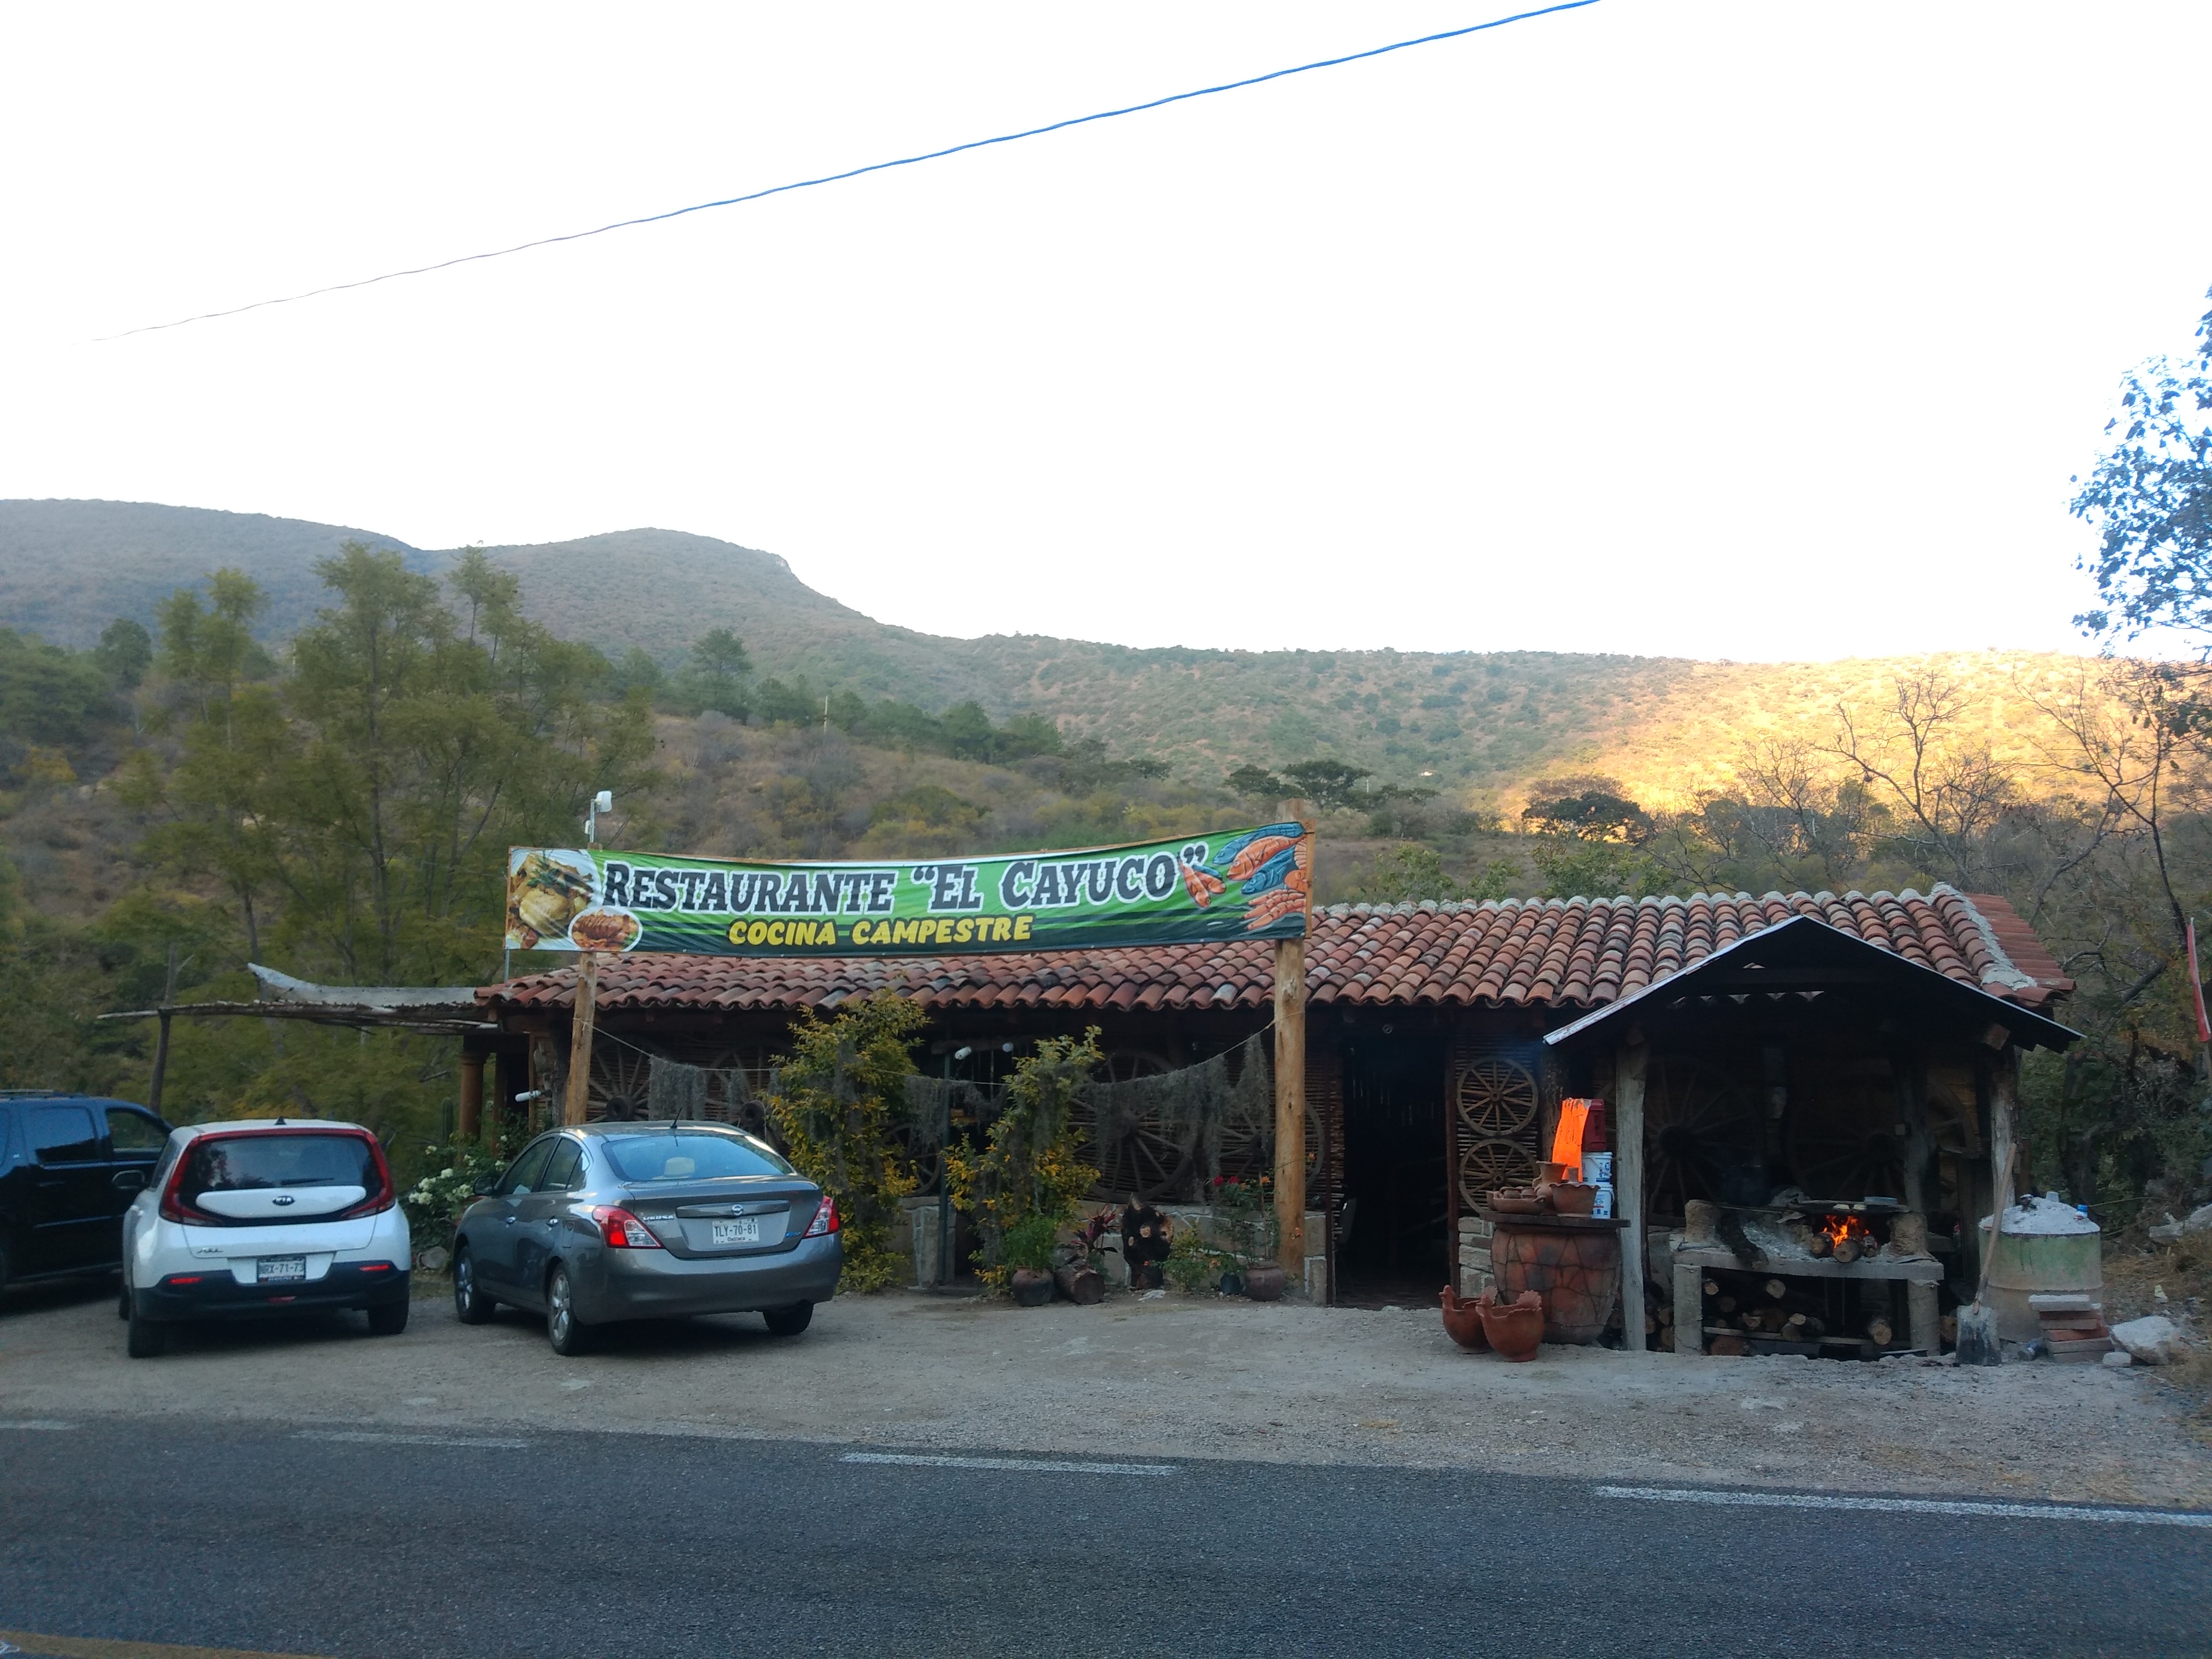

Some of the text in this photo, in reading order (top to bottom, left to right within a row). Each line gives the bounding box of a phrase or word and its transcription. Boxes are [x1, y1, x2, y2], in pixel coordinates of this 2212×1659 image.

[602, 862, 898, 913] RESTAURANTE
[729, 916, 1034, 945] COCINA CAMPESTRE
[714, 1224, 756, 1237] TLY-70-81
